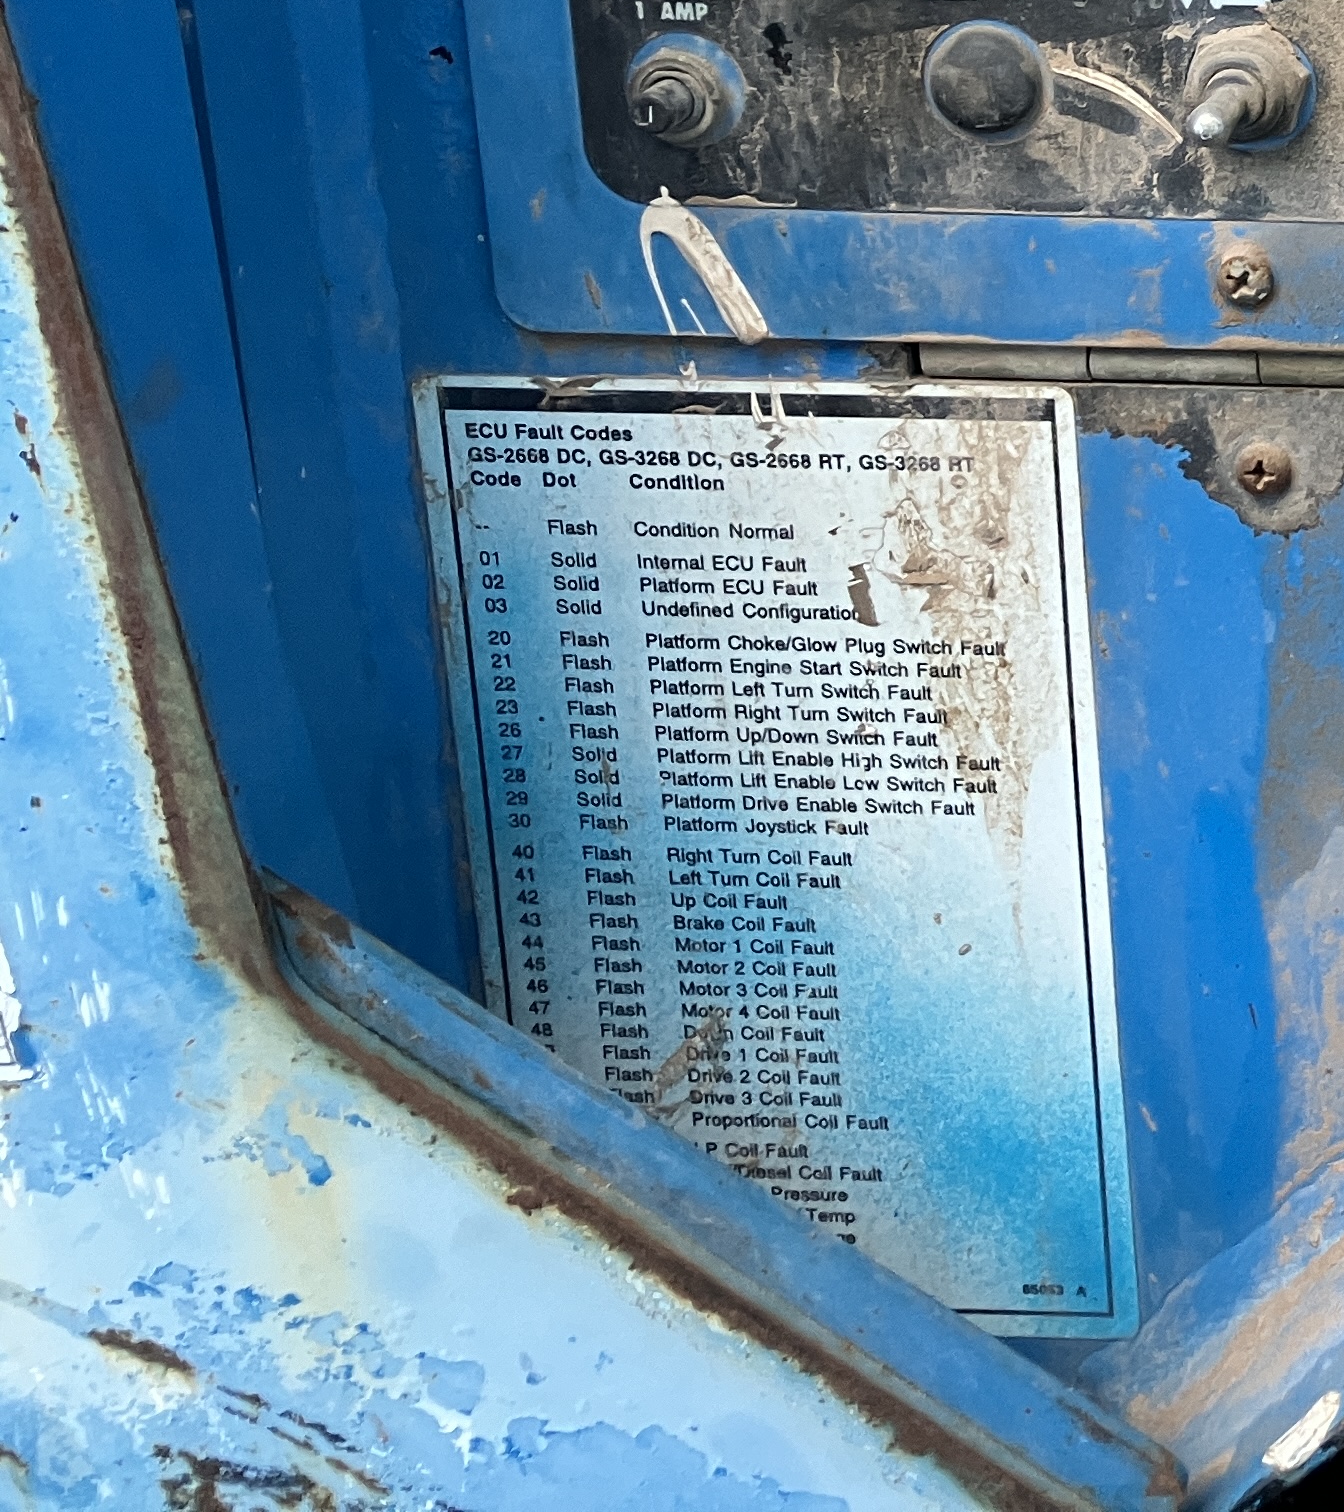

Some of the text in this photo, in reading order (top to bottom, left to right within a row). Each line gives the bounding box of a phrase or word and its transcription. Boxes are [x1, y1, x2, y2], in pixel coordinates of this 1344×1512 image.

[634, 1, 709, 22] 1 AMP
[464, 422, 634, 443] ECU Fault Codes
[467, 446, 975, 473] GS-2668 DC, GS-3268 DC, GS-2668 RT, GS-3268 RT
[470, 469, 725, 491] Code Dot Condition
[547, 519, 795, 541] Flash Condition Normal
[479, 550, 807, 573] 01 Solid Internal ECU Fault
[482, 574, 819, 596] 02 Solid Platform ECU Fault
[484, 597, 508, 613] 03
[556, 598, 602, 615] Solid
[641, 600, 734, 619] Undefined
[488, 630, 1008, 658] 20 Flash Platform Choke/Glow Plug Switch Fault
[490, 653, 962, 680] 21 Flash Platform Engine Start Switch Fault
[493, 675, 933, 702] 22 Flash Platform Left Turn Switch Fault
[496, 699, 949, 725] 23 Flash Platform Right Turn Switch Fault
[499, 722, 522, 738] 26
[569, 723, 619, 740] Flash
[654, 725, 730, 743] Platform
[736, 726, 819, 748] Up/Down
[893, 730, 939, 748] Fault
[500, 745, 523, 761] 27
[656, 747, 731, 766] Platform
[738, 749, 766, 767] Lift
[771, 750, 834, 768] Enable
[889, 753, 949, 771] Switch
[955, 752, 1003, 772] Fault
[740, 772, 768, 789] Lift
[773, 773, 836, 790] Enable
[886, 775, 946, 793] Switch
[952, 775, 998, 795] Fault
[576, 791, 623, 808] Solid
[661, 793, 736, 812] Platform
[742, 795, 789, 812] Drive
[796, 796, 858, 813] Enable
[864, 798, 924, 816] Switch
[930, 799, 976, 817] Fault
[508, 813, 869, 838] 30 Flash Platform Joystick Fault
[512, 844, 853, 867] 40 Flash Right Turn Coil Fault
[515, 867, 842, 890] 41 Flash Left Turn Coil Fault
[516, 889, 788, 912] 42 Flash Up Coil Fault
[519, 912, 817, 934] 43 Flash Brake Coil Fault
[691, 1110, 890, 1132] Proportional Coil Fault
[805, 1210, 857, 1227] Temp
